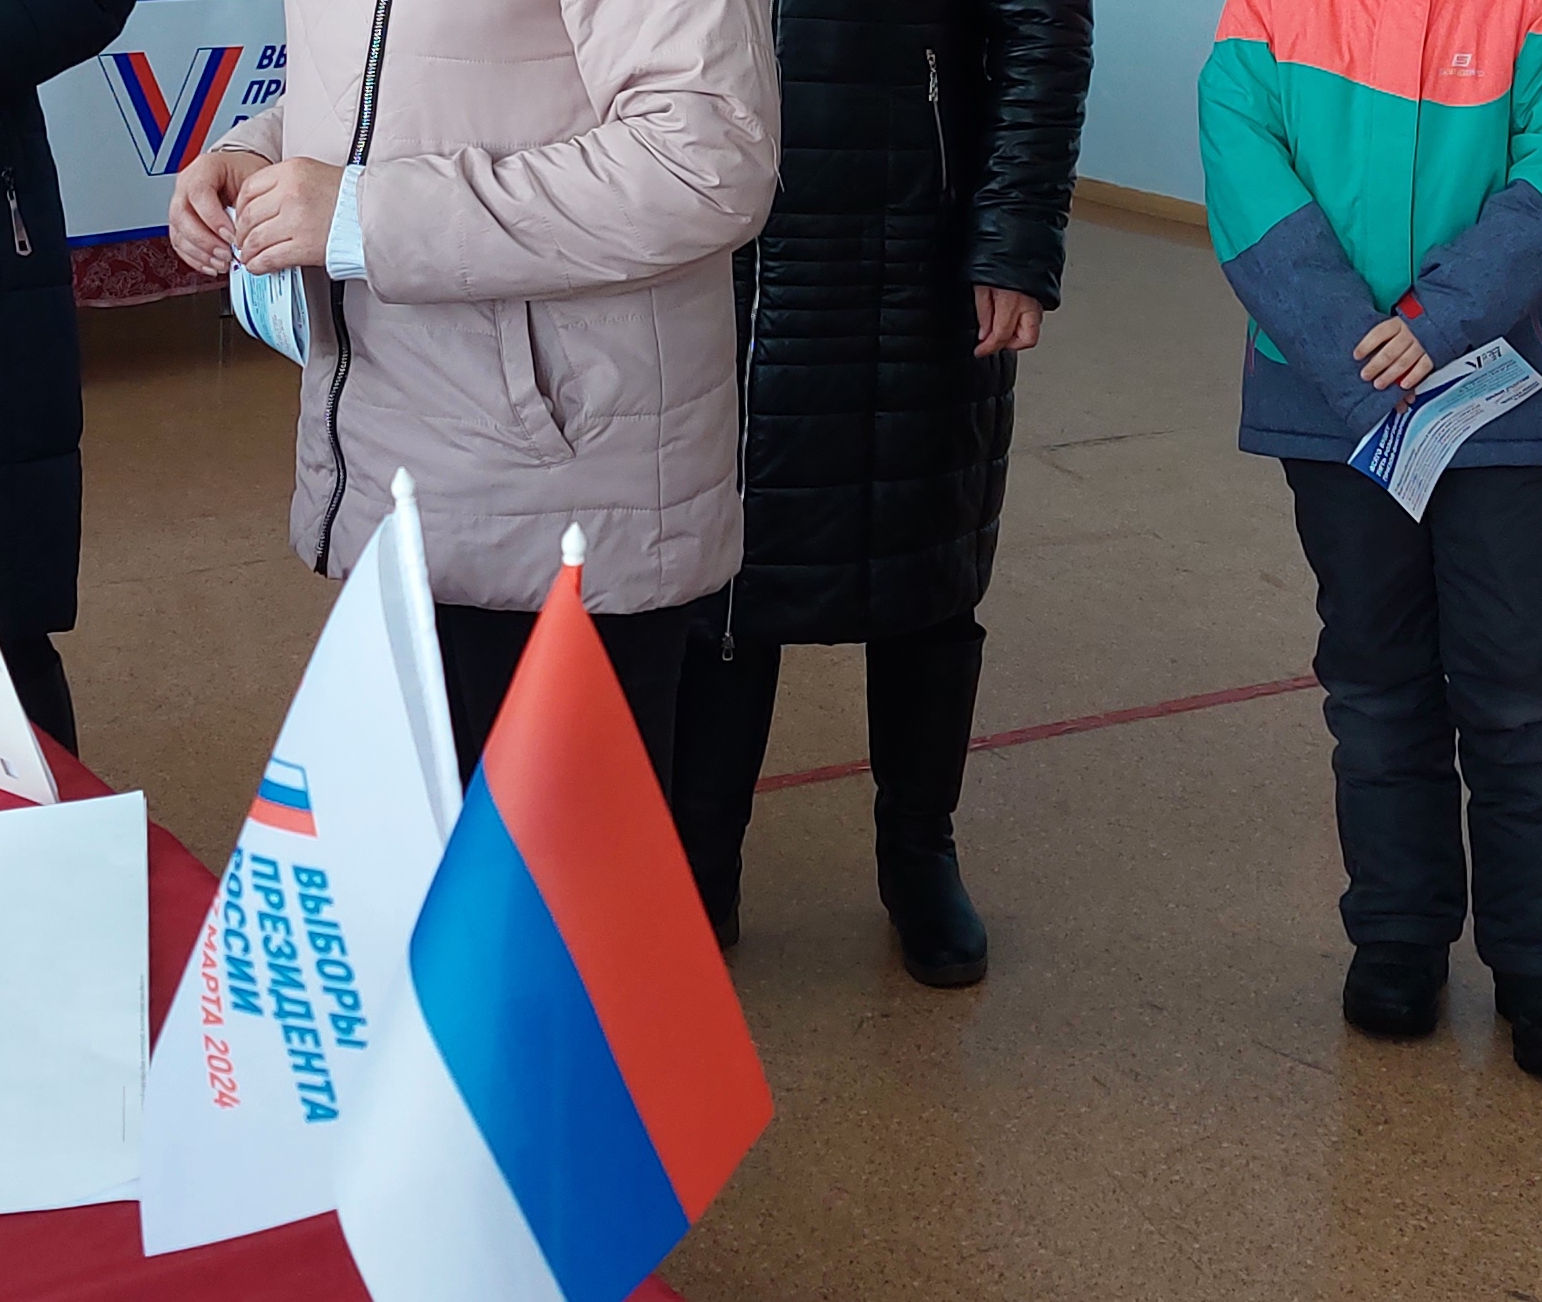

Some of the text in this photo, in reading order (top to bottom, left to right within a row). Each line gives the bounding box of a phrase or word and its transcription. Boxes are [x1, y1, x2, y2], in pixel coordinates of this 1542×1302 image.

[250, 853, 340, 1124] ПРЕЗИДЕНТА
[291, 864, 369, 1050] ВЫБОРЫ
[203, 1034, 242, 1110] 2024
